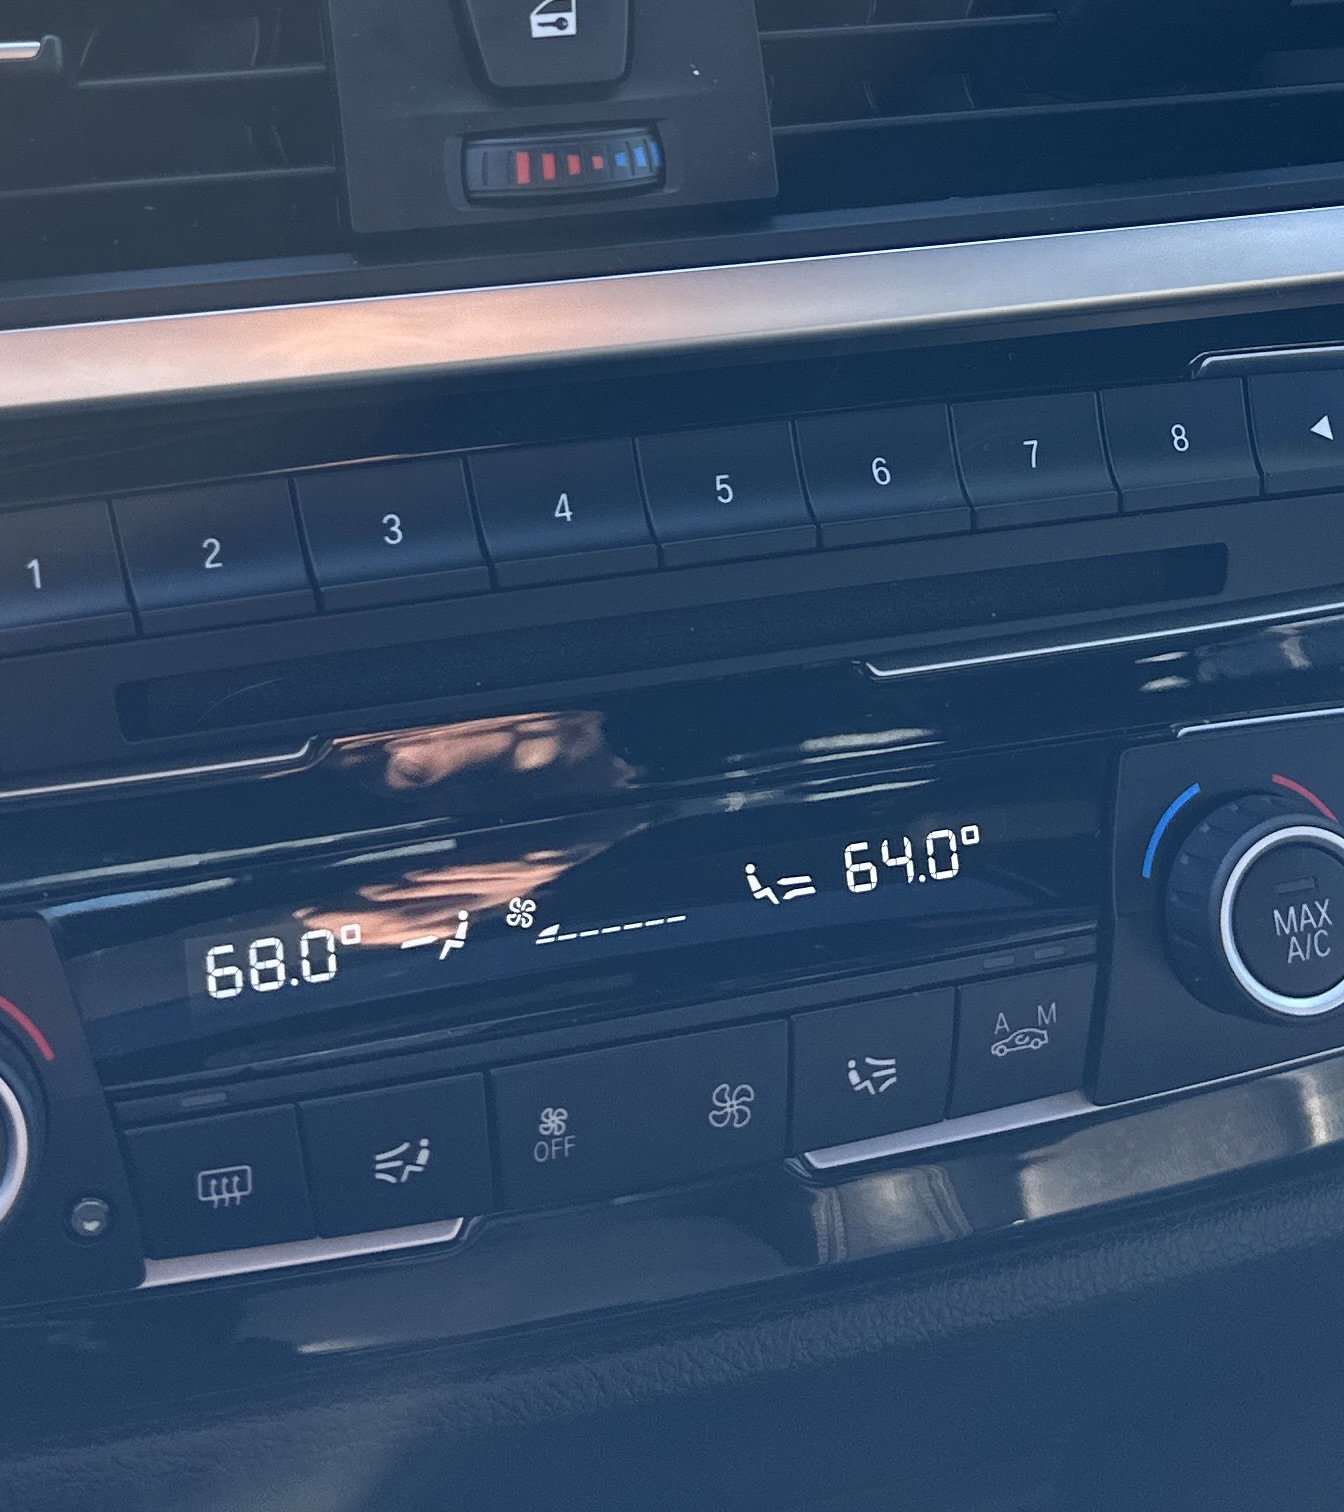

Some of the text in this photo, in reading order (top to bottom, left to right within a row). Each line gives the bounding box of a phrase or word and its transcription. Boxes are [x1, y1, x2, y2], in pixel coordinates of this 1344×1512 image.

[1171, 423, 1190, 453] 8
[1023, 439, 1040, 469] 7
[871, 456, 892, 486] 6
[715, 474, 734, 505] 5
[553, 492, 574, 524] 4
[383, 514, 404, 546] 3
[202, 537, 223, 569] 2
[27, 558, 43, 589] 1
[1273, 902, 1333, 937] MAX
[1287, 930, 1333, 965] A/C
[994, 1001, 1057, 1036] A M
[534, 1137, 575, 1165] OFF
